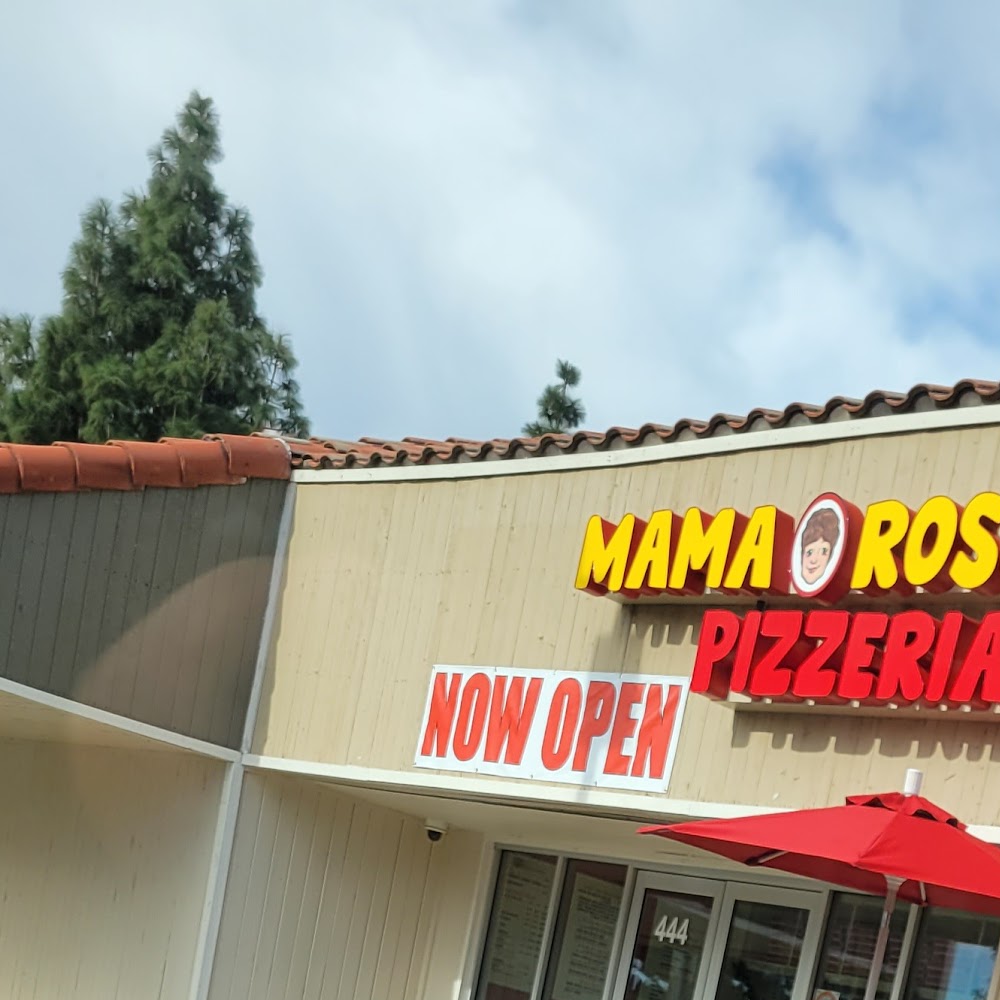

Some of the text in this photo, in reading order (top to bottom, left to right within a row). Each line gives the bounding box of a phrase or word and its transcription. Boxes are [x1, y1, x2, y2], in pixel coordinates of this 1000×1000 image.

[574, 505, 777, 592] MAMA
[420, 672, 683, 780] NOW OPEN
[653, 914, 690, 946] 444
